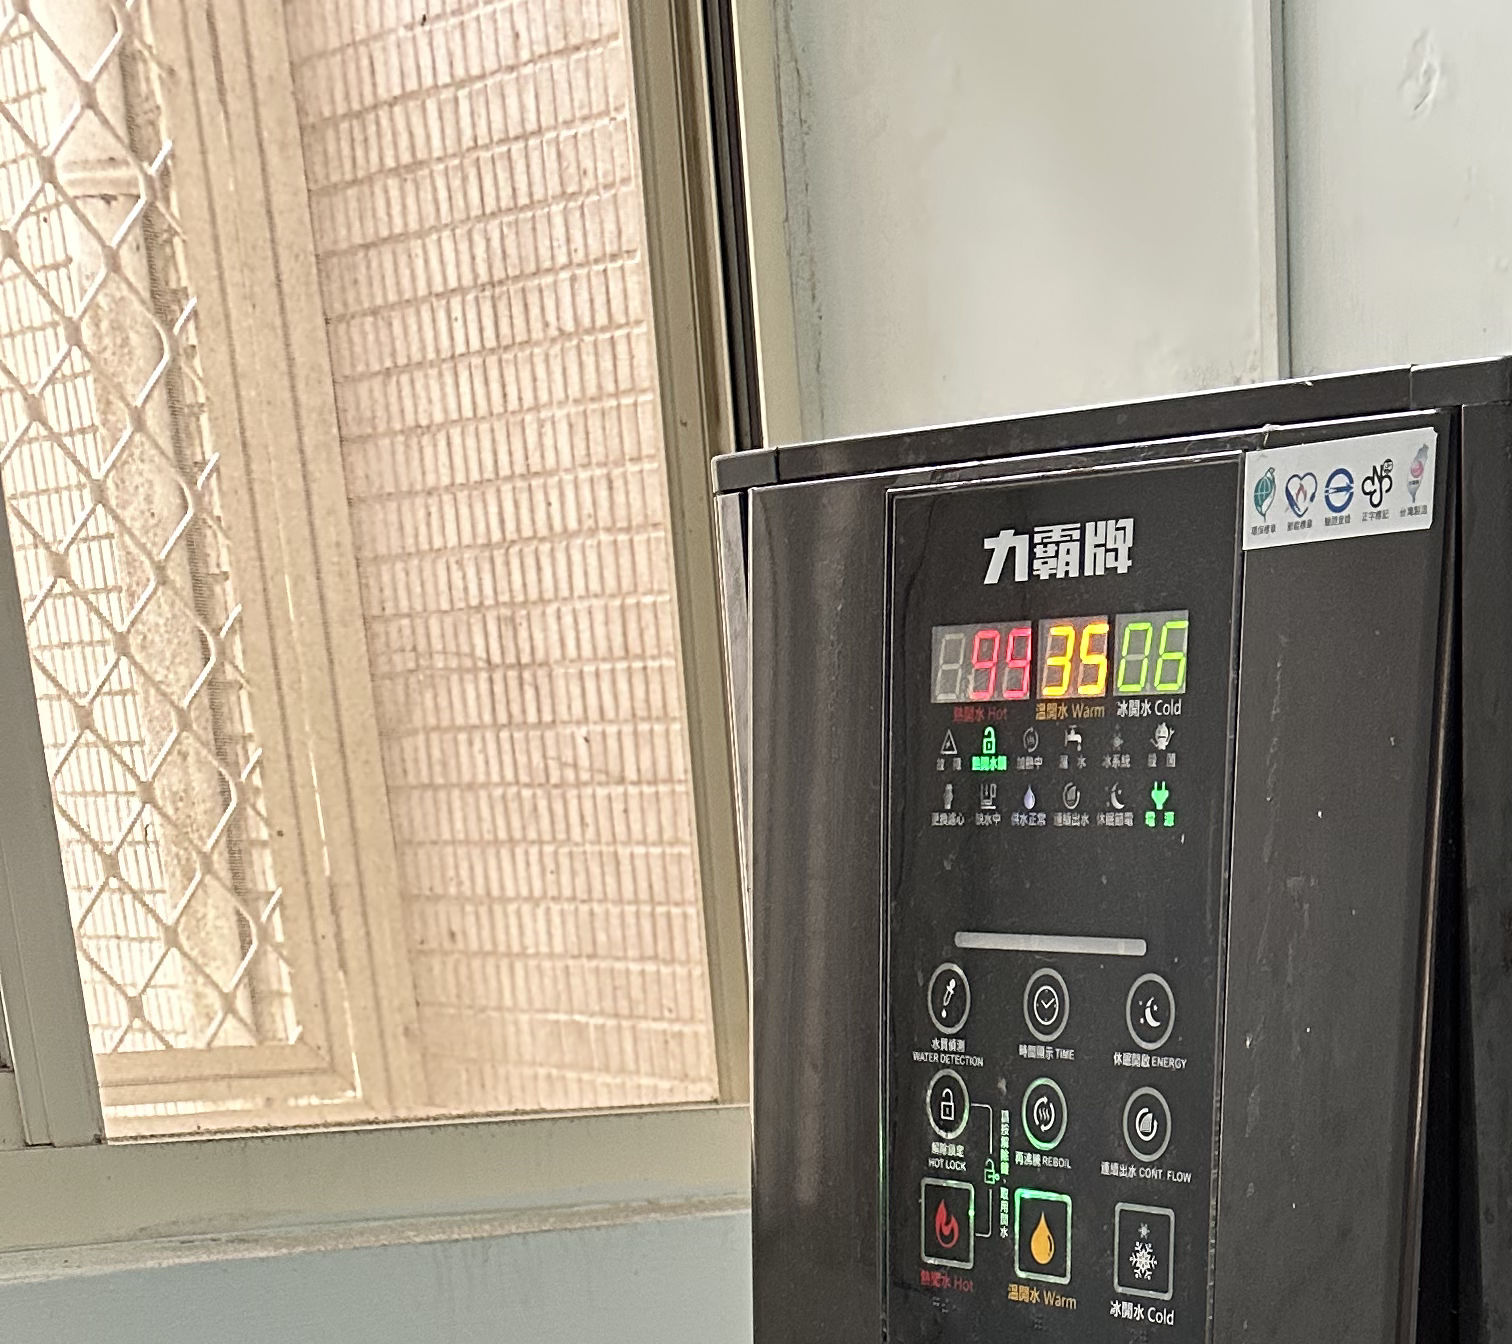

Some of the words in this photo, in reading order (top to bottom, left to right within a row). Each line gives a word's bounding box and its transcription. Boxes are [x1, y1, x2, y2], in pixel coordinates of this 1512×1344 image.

[983, 517, 1135, 585] 力霸牌
[1042, 622, 1110, 696] 35
[1117, 620, 1190, 692] 06
[1035, 702, 1069, 721] 溫開水
[1071, 702, 1106, 719] Warm
[1116, 700, 1152, 719] 冰開水
[1154, 698, 1182, 717] Cold
[1010, 810, 1048, 827] 供水正常
[912, 1050, 940, 1064] WATER
[939, 1054, 984, 1068] DETECTION
[1018, 1043, 1055, 1061] 時間顯示
[1055, 1048, 1076, 1061] TIME
[1151, 1055, 1187, 1070] ENERGY
[928, 1158, 945, 1170] HOT
[945, 1159, 967, 1172] LOCK
[1042, 1155, 1072, 1170] REBOIL
[1166, 1170, 1192, 1183] FLOW
[954, 1275, 975, 1292] Hot
[1007, 1283, 1041, 1304] 溫開水
[1043, 1289, 1078, 1310] Warm
[1110, 1300, 1146, 1322] 冰開水
[1147, 1306, 1175, 1326] Cold
